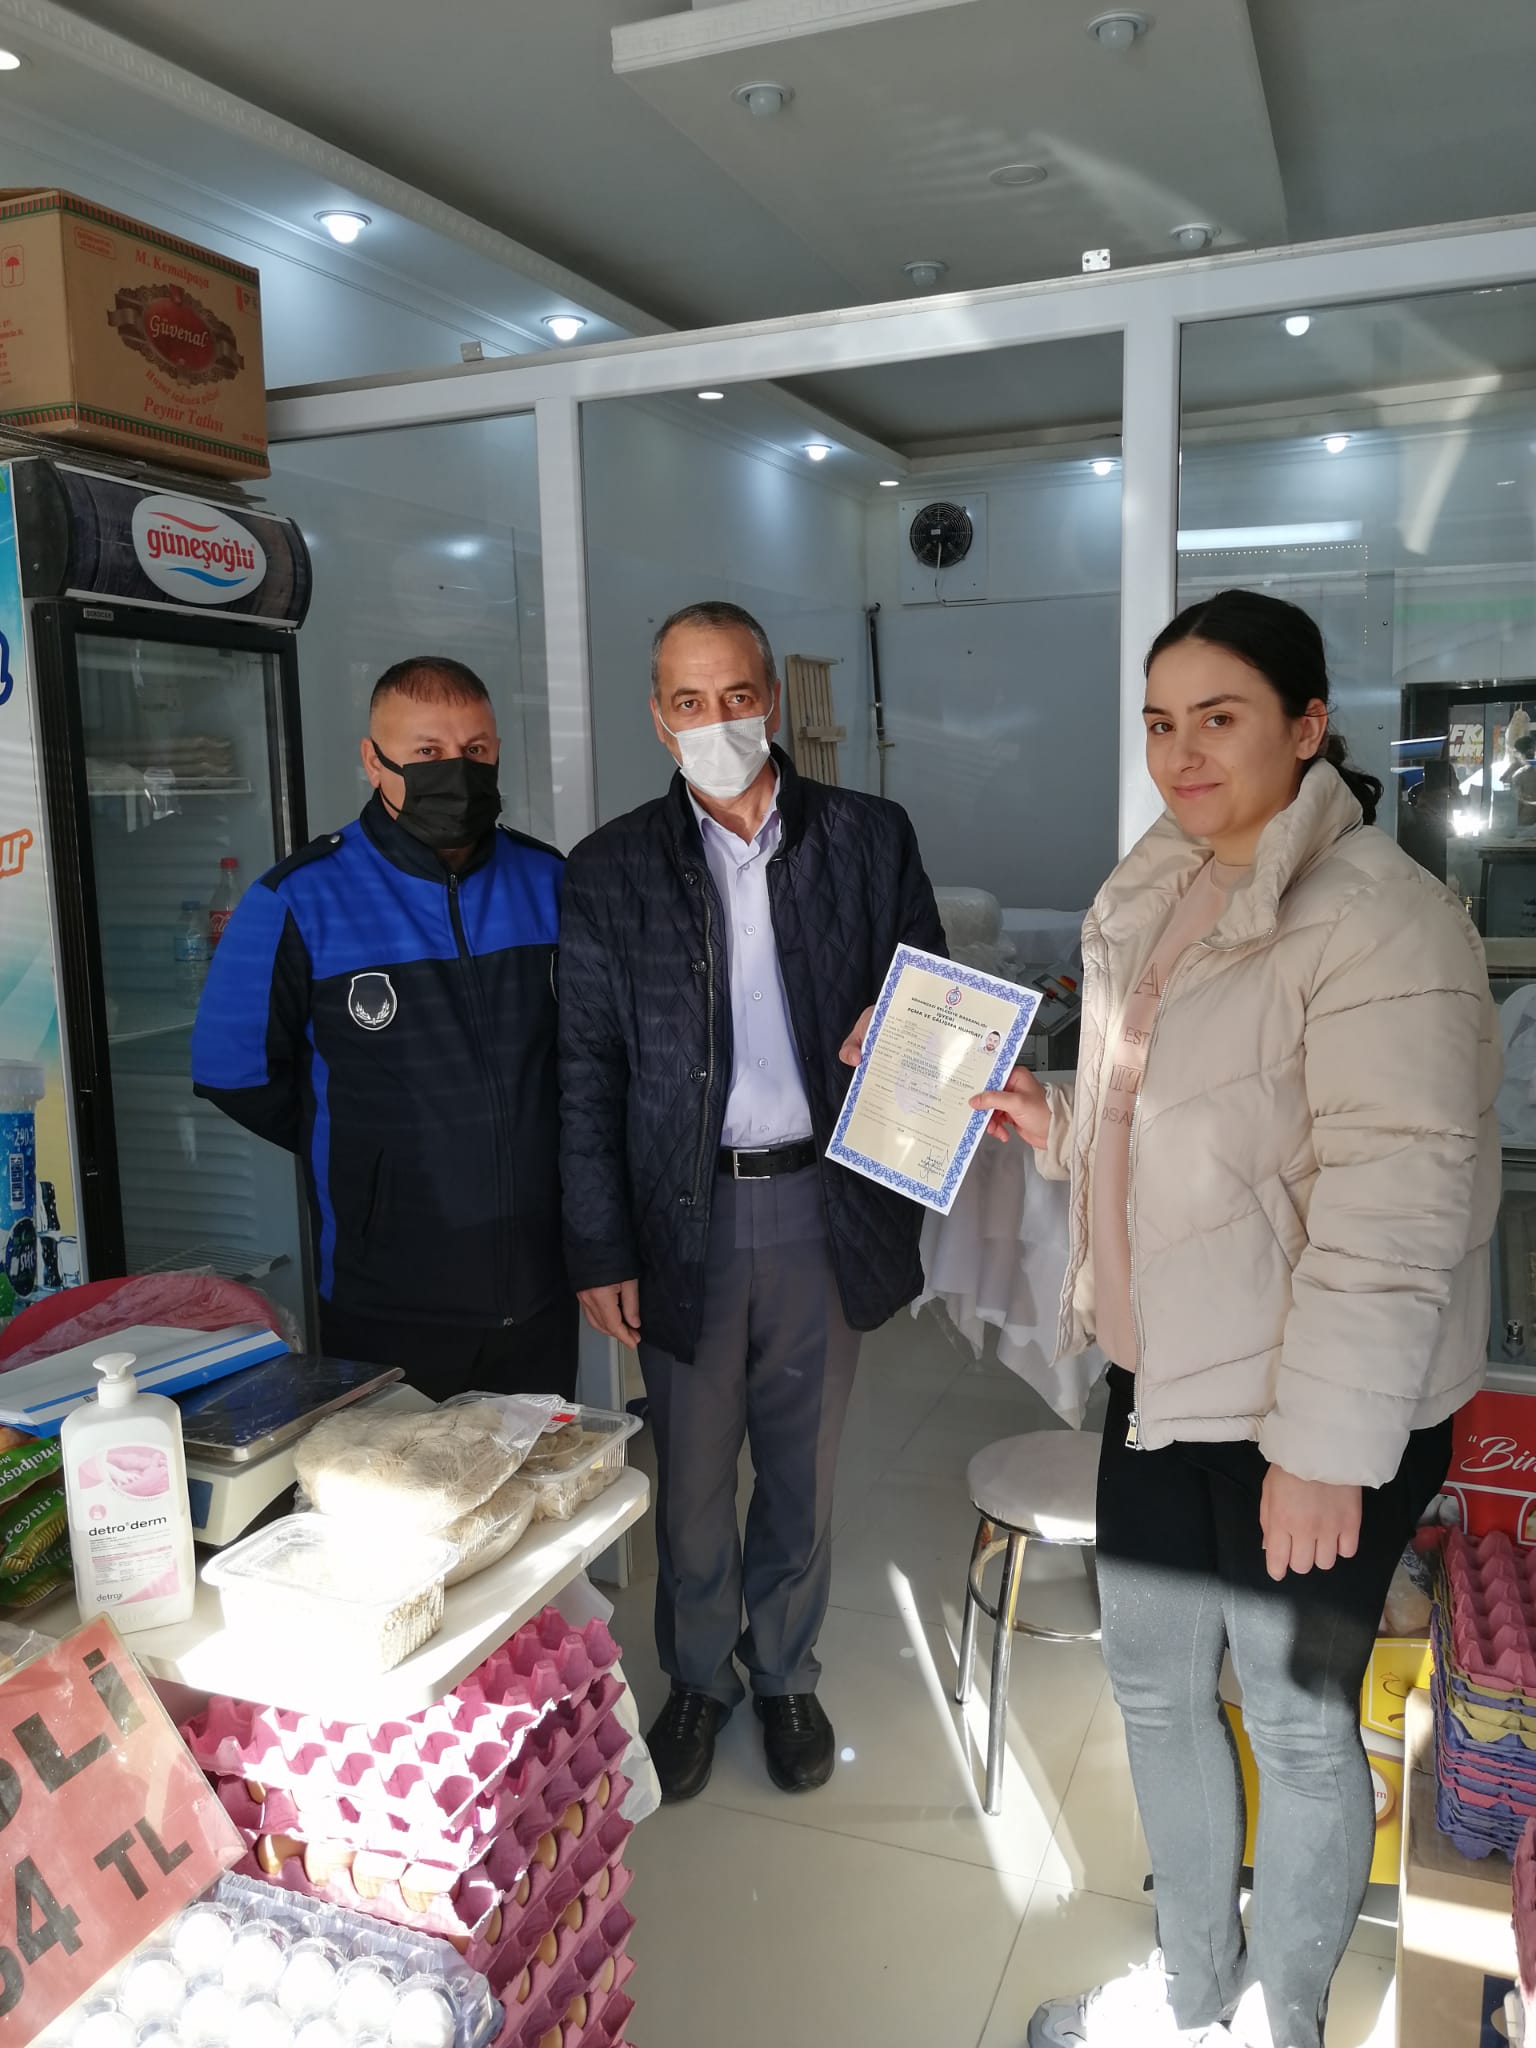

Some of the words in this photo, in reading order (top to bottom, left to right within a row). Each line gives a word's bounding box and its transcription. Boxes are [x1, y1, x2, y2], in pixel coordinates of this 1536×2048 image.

[150, 315, 209, 348] Güvenal
[147, 525, 255, 573] güneşoğlu
[5, 1496, 52, 1543] Peynir
[94, 1816, 194, 1901] TL
